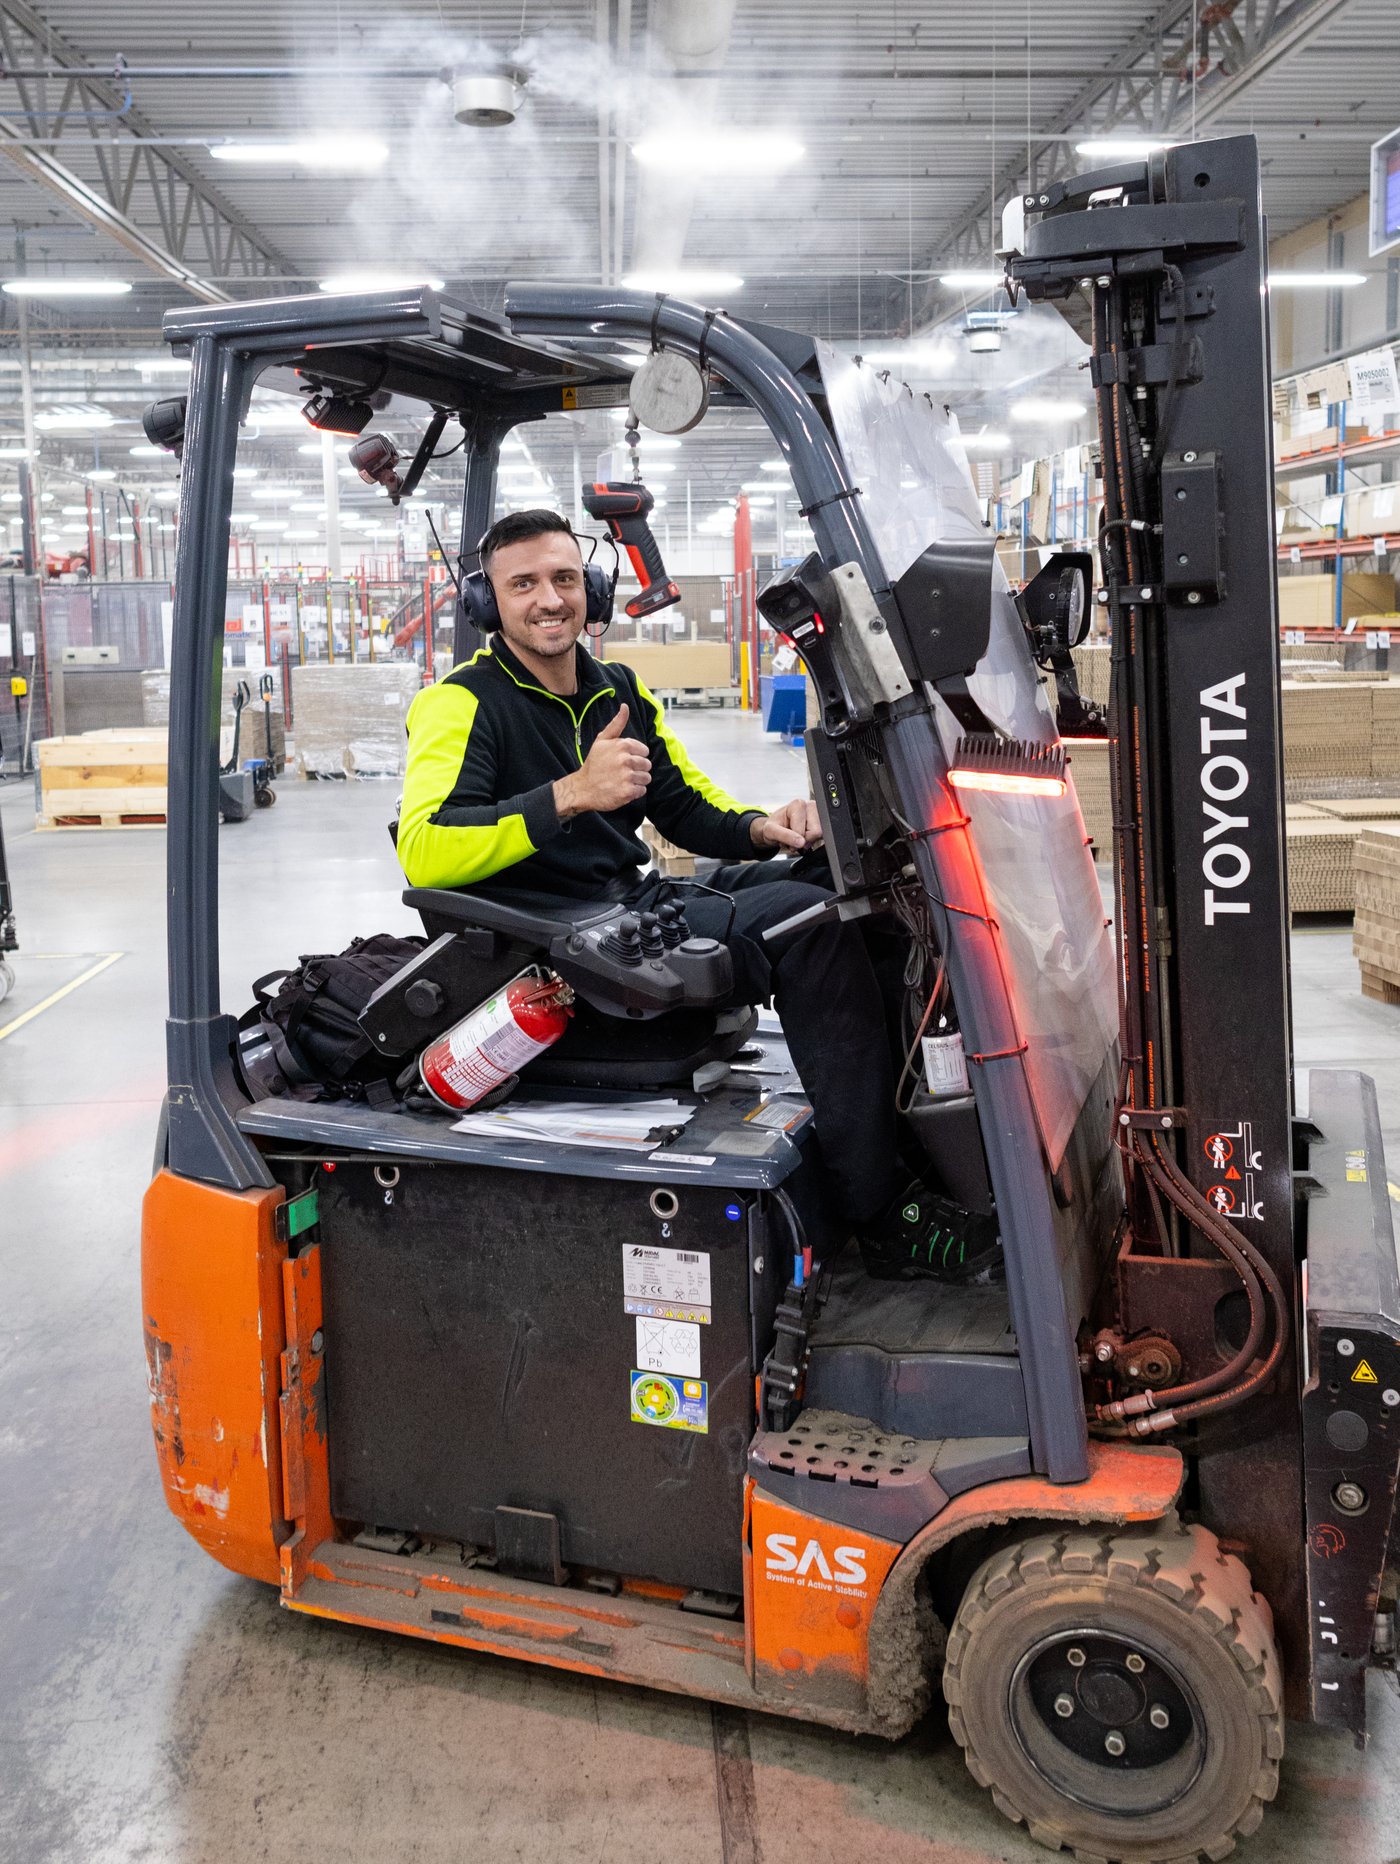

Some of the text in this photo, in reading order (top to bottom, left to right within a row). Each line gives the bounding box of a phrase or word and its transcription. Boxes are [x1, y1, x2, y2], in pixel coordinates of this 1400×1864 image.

[1357, 368, 1390, 380] M9050002
[1200, 672, 1251, 926] TOYOTA
[648, 1357, 663, 1368] Pb
[765, 1533, 867, 1585] SAS
[765, 1571, 795, 1585] System
[807, 1579, 833, 1592] Active
[834, 1584, 868, 1600] Stability
